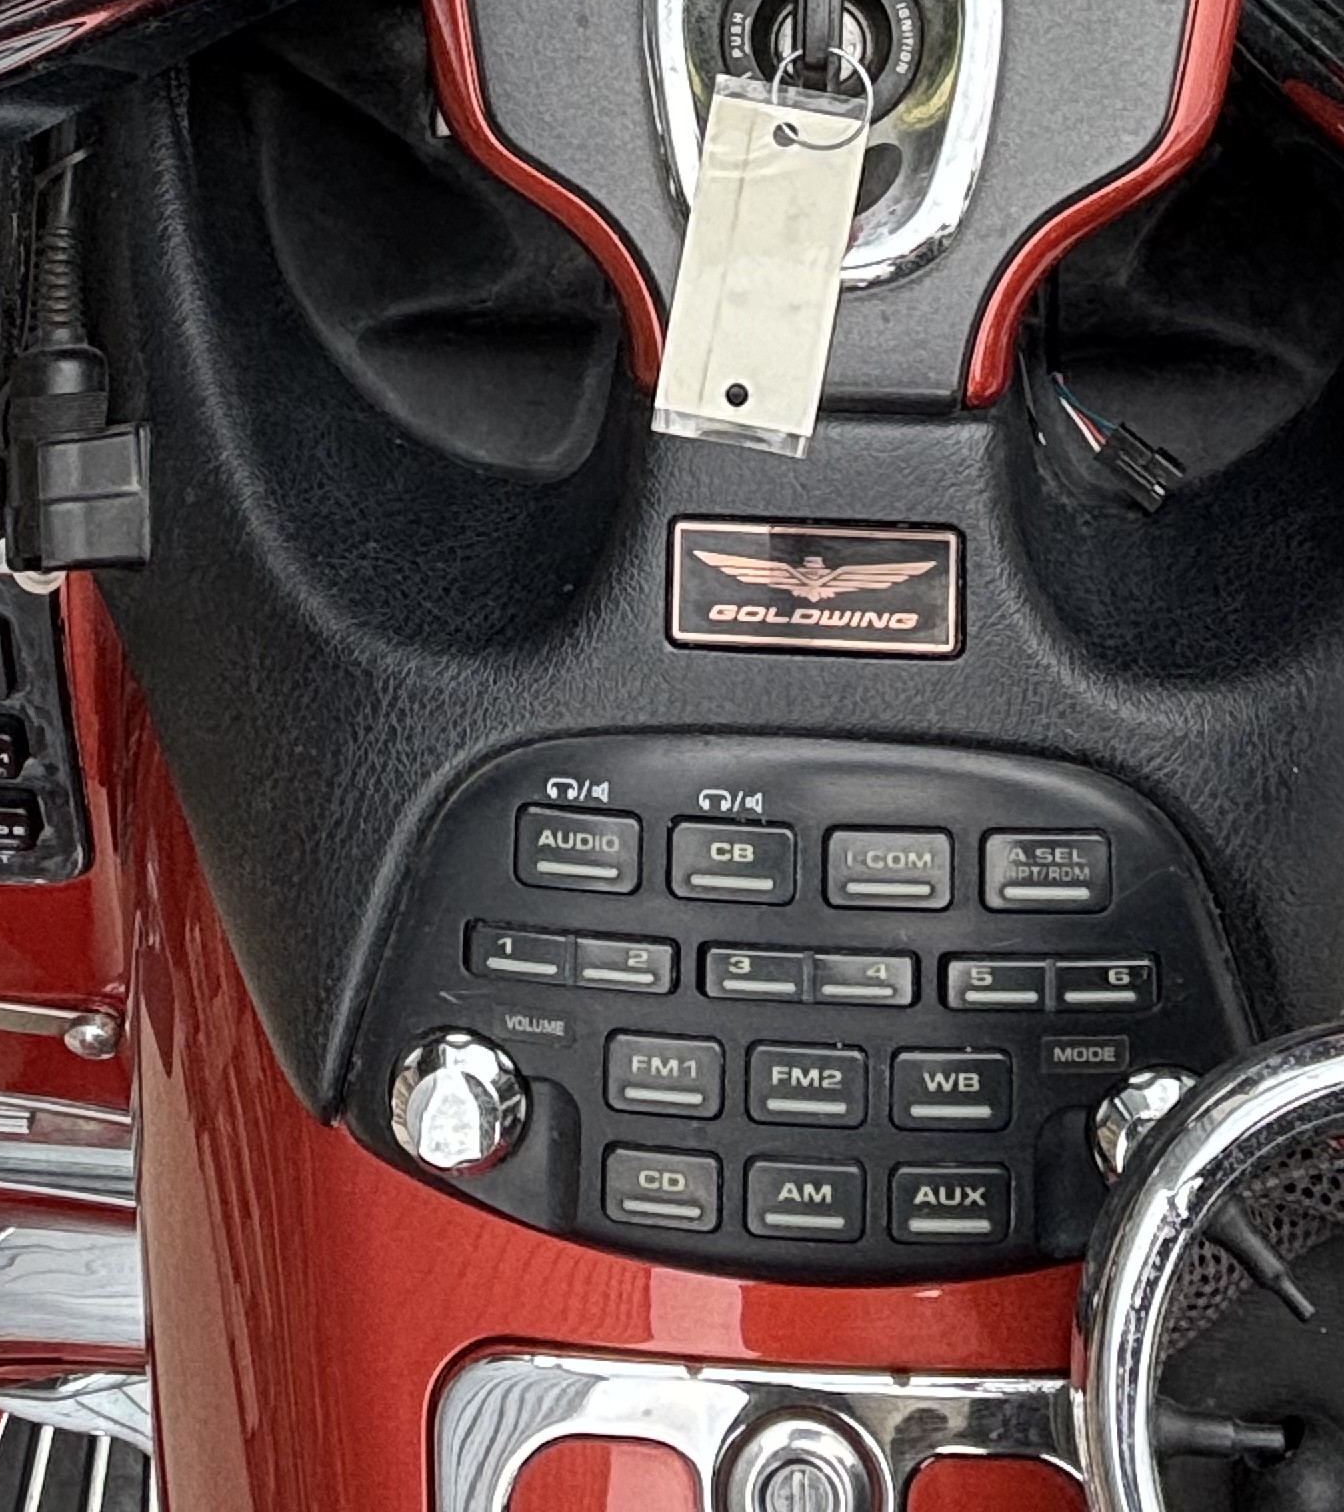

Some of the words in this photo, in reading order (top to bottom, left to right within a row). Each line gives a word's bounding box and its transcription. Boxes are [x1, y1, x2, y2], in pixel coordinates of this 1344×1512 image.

[730, 12, 745, 58] PUSH
[895, 2, 914, 74] IGNITION
[709, 604, 919, 630] GOLDWING
[0, 753, 10, 764] 1
[537, 829, 620, 852] AUDIO
[710, 842, 755, 863] CB
[497, 937, 513, 955] 1
[627, 950, 649, 968] 2
[728, 956, 752, 974] 3
[866, 963, 888, 980] 4
[970, 968, 993, 986] 5
[1108, 968, 1131, 986] 6
[505, 1014, 566, 1036] VOLUME
[1053, 1047, 1116, 1063] MODE
[631, 1055, 697, 1079] FM1
[771, 1066, 843, 1089] FM2
[923, 1072, 981, 1093] WB
[638, 1170, 686, 1192] CD
[777, 1184, 833, 1205] AM
[913, 1186, 987, 1206] AUX
